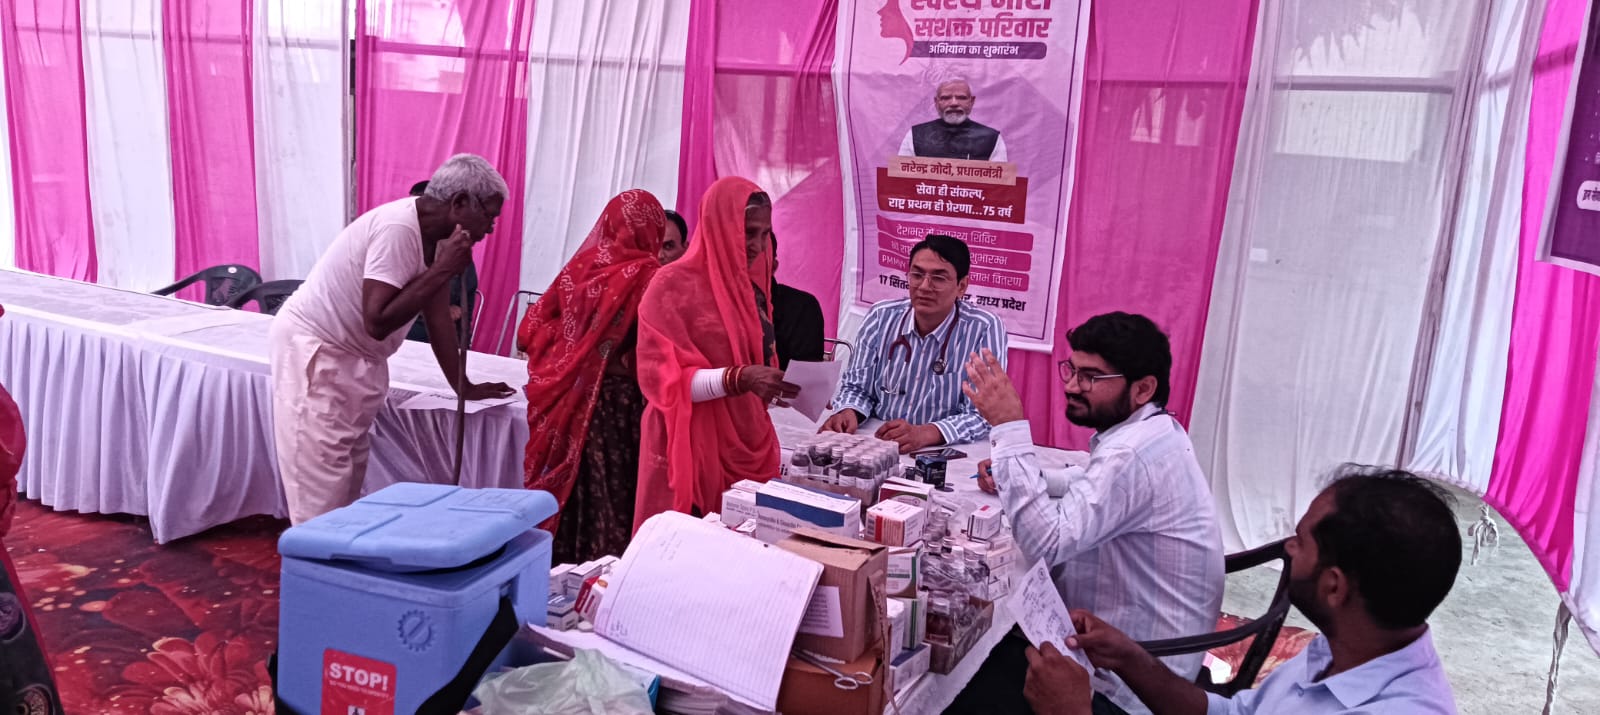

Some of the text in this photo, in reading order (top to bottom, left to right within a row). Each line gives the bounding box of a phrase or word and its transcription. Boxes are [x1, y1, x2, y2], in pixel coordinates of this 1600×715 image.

[979, 12, 1053, 38] परिवार
[929, 42, 1020, 58] अभियान का शुभारंभ
[901, 162, 1003, 179] नरेन्द्र मोदी, प्रधानमंत्री
[916, 182, 986, 200] सेवा ही संकल्प,
[907, 198, 932, 212] प्रथम
[934, 199, 944, 212] ही
[997, 204, 1013, 218] वर्ष
[896, 223, 924, 238] देशभर
[970, 231, 997, 245] शिविर
[879, 274, 910, 290] 17 सित
[970, 272, 1022, 287] लाभ वितरण
[976, 295, 1000, 308] मध्य
[1002, 296, 1027, 312] प्रदेश
[329, 662, 389, 692] STOP!
